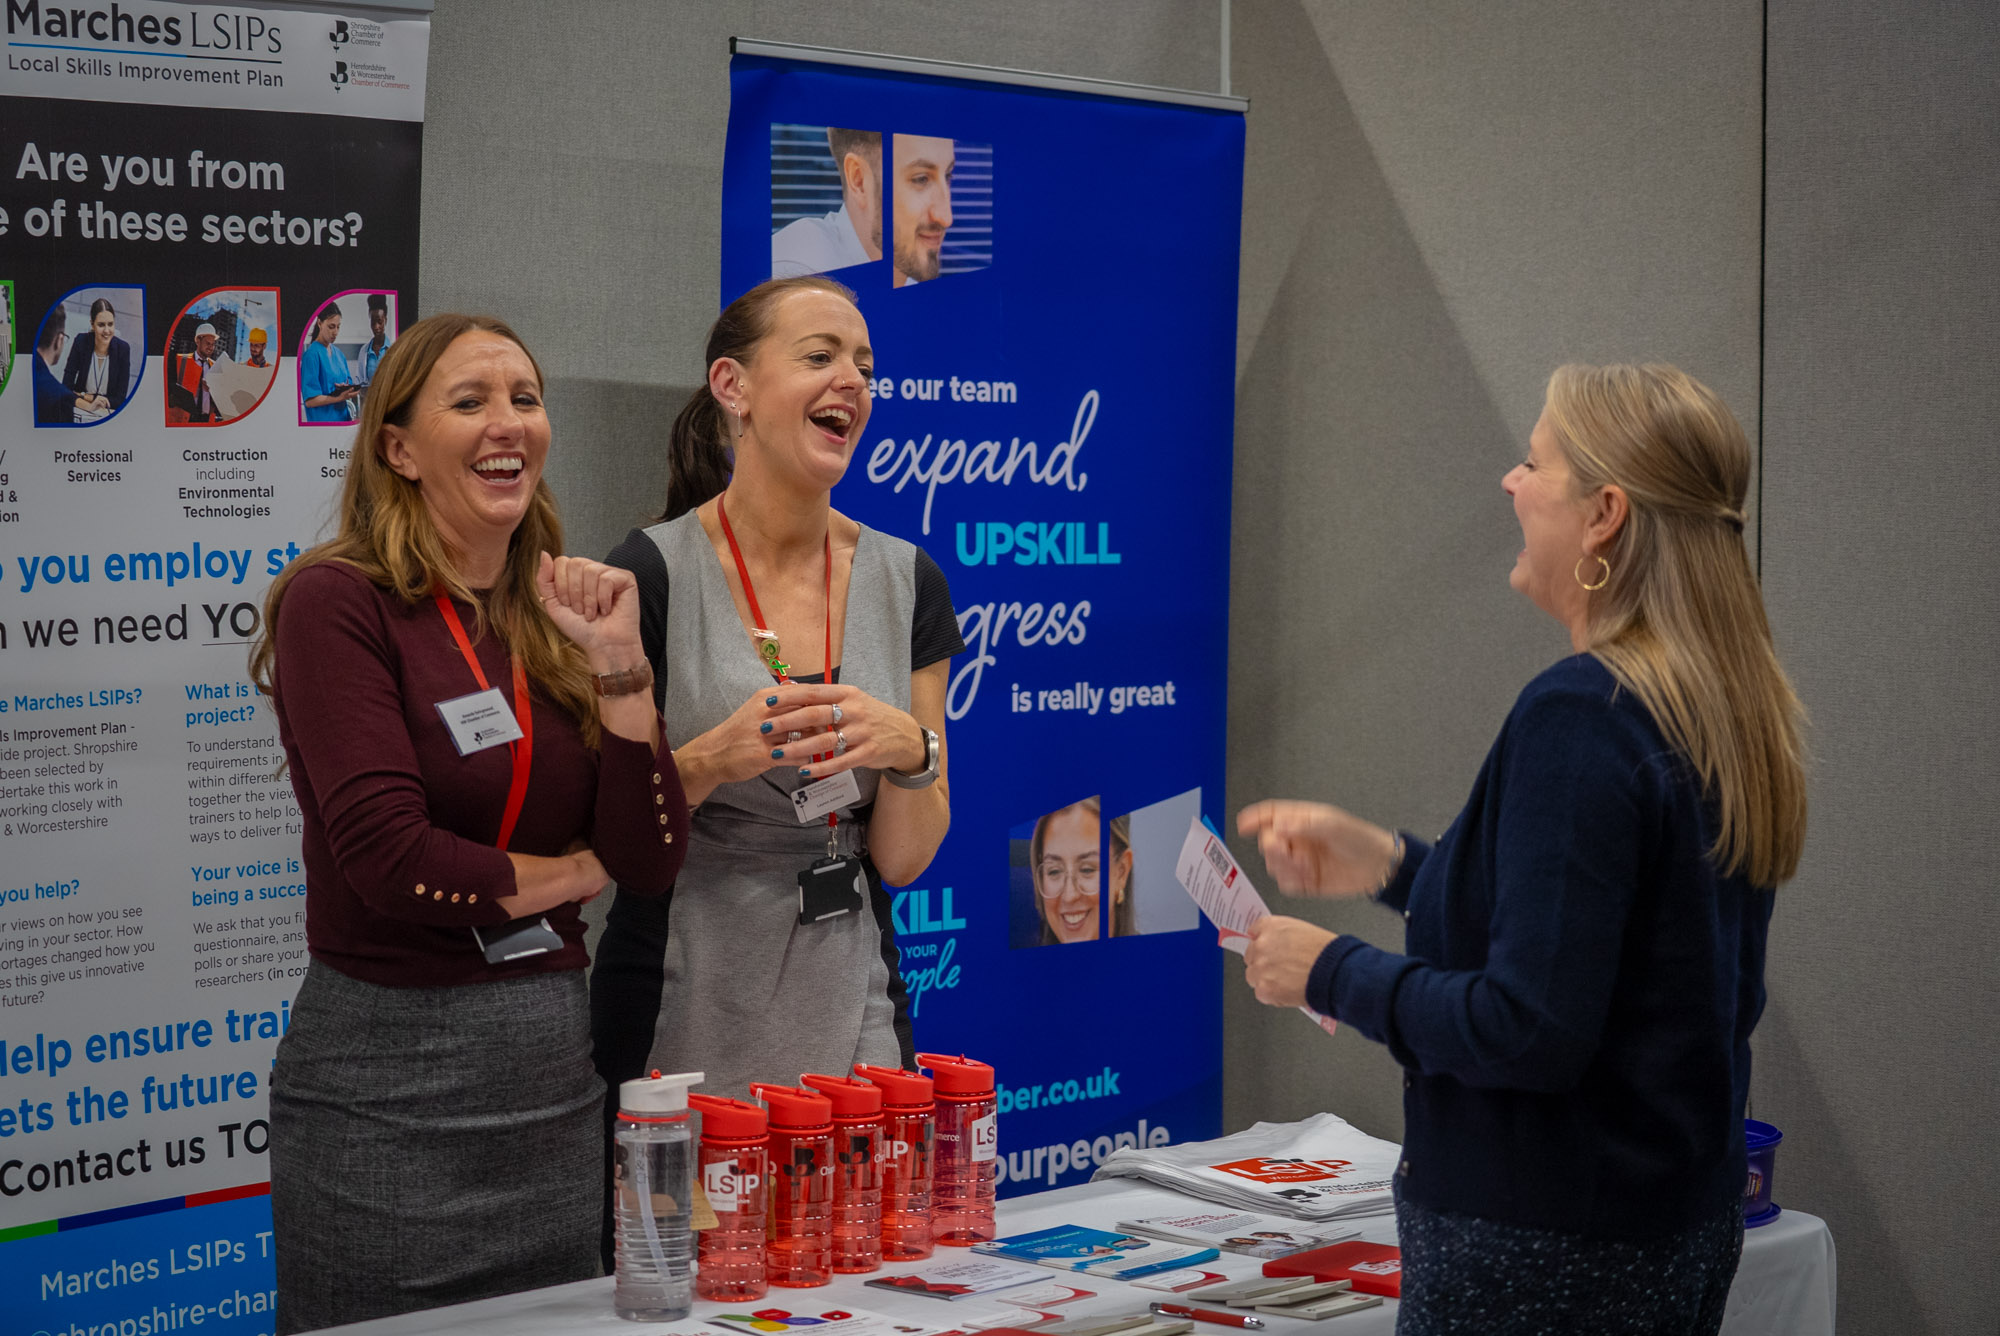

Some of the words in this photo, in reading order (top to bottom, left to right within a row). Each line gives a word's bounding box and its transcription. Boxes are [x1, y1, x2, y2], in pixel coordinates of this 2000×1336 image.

[7, 0, 182, 46] Marches
[191, 11, 282, 53] LSIPs
[350, 22, 381, 32] Shropshire
[351, 30, 377, 39] Chamber
[351, 37, 381, 46] Commerce
[8, 54, 59, 73] Local
[66, 58, 112, 77] Skills
[119, 61, 240, 85] Improvement
[247, 69, 283, 87] Plan
[351, 62, 386, 72] Herefordshire
[357, 71, 395, 80] Worcestershire
[351, 78, 374, 87] Chamber
[381, 81, 410, 89] Commerce
[16, 143, 88, 182] Are
[101, 154, 175, 191] you
[188, 150, 285, 190] from
[24, 199, 66, 238] of
[78, 201, 188, 242] these
[202, 210, 363, 247] sectors?
[869, 377, 894, 400] ee
[900, 378, 944, 401] our
[949, 376, 1017, 403] team
[54, 450, 133, 463] Professional
[183, 449, 268, 462] Construction
[329, 448, 352, 460] Hea
[867, 389, 1100, 536] expand,
[67, 470, 121, 482] Services
[196, 468, 255, 482] including
[321, 466, 347, 478] Soci
[179, 486, 274, 500] Environmental
[183, 505, 270, 519] Technologies
[956, 521, 1122, 566] UPSKILL
[17, 555, 90, 593] you
[104, 542, 252, 587] employ
[266, 541, 303, 576] st
[22, 618, 78, 648] we
[94, 604, 188, 644] need
[202, 602, 260, 640] YO
[945, 600, 1091, 721] gress
[14, 693, 84, 712] Marches
[89, 688, 142, 707] LSIPs?
[185, 683, 230, 700] What
[236, 682, 249, 697] is
[1011, 683, 1032, 713] is
[1038, 682, 1104, 715] really
[1109, 680, 1176, 714] great
[186, 705, 255, 728] project?
[13, 724, 97, 742] Improvement
[101, 722, 126, 735] Plan
[24, 745, 70, 761] project.
[74, 739, 138, 756] Shropshire
[187, 741, 201, 753] To
[204, 736, 275, 752] understand
[0, 767, 31, 780] been
[34, 761, 85, 777] selected
[89, 760, 104, 774] by
[187, 755, 268, 772] requirements
[272, 753, 283, 765] in
[0, 784, 45, 799] dertake
[48, 781, 70, 795] this
[74, 778, 104, 792] work
[107, 777, 118, 789] in
[188, 776, 225, 789] within
[51, 798, 93, 813] closely
[97, 795, 123, 809] with
[188, 793, 241, 808] together
[245, 791, 265, 803] the
[4, 823, 13, 836] &
[17, 815, 108, 835] Worcestershire
[189, 812, 235, 826] trainers
[239, 810, 252, 821] to
[255, 806, 282, 820] help
[190, 831, 220, 844] ways
[224, 829, 236, 840] to
[240, 825, 282, 839] deliver
[285, 823, 302, 835] fut
[191, 866, 231, 882] Your
[236, 860, 281, 877] voice
[287, 858, 300, 873] is
[0, 888, 29, 908] you
[35, 879, 80, 899] help?
[192, 889, 239, 906] being
[244, 889, 254, 901] a
[259, 884, 307, 900] succe
[11, 918, 45, 931] views
[49, 916, 64, 927] on
[68, 912, 93, 925] how
[97, 910, 119, 923] you
[122, 907, 143, 918] see
[891, 887, 967, 935] KILL
[193, 922, 213, 934] We
[216, 919, 237, 932] ask
[240, 916, 265, 930] that
[268, 915, 291, 929] you
[28, 936, 39, 948] in
[43, 933, 70, 949] your
[74, 929, 113, 943] sector.
[117, 924, 144, 937] How
[193, 933, 279, 954] questionnaire,
[1, 955, 48, 969] ortages
[51, 947, 102, 963] changed
[105, 945, 130, 958] how
[133, 941, 155, 955] you
[194, 957, 222, 973] polls
[225, 957, 238, 967] or
[241, 952, 274, 965] share
[277, 949, 304, 963] your
[905, 944, 938, 959] YOUR
[15, 973, 37, 987] this
[40, 970, 66, 986] give
[69, 969, 82, 980] us
[85, 961, 145, 978] innovative
[195, 972, 264, 989] researchers
[268, 968, 284, 981] (in
[899, 938, 961, 1018] ople
[2, 991, 45, 1007] future?
[85, 1019, 213, 1063] ensure
[225, 1000, 290, 1043] trai
[996, 1066, 1121, 1114] ber.co.uk
[0, 1099, 54, 1137] ets
[66, 1086, 129, 1126] the
[141, 1070, 258, 1114] future
[976, 1126, 996, 1146] LS
[0, 1139, 151, 1196] Contact
[165, 1136, 206, 1168] us
[218, 1119, 271, 1158] TO
[708, 1173, 760, 1195] LSIP
[41, 1257, 160, 1301] Marches
[170, 1239, 246, 1275] LSIPs
[255, 1231, 273, 1258] T
